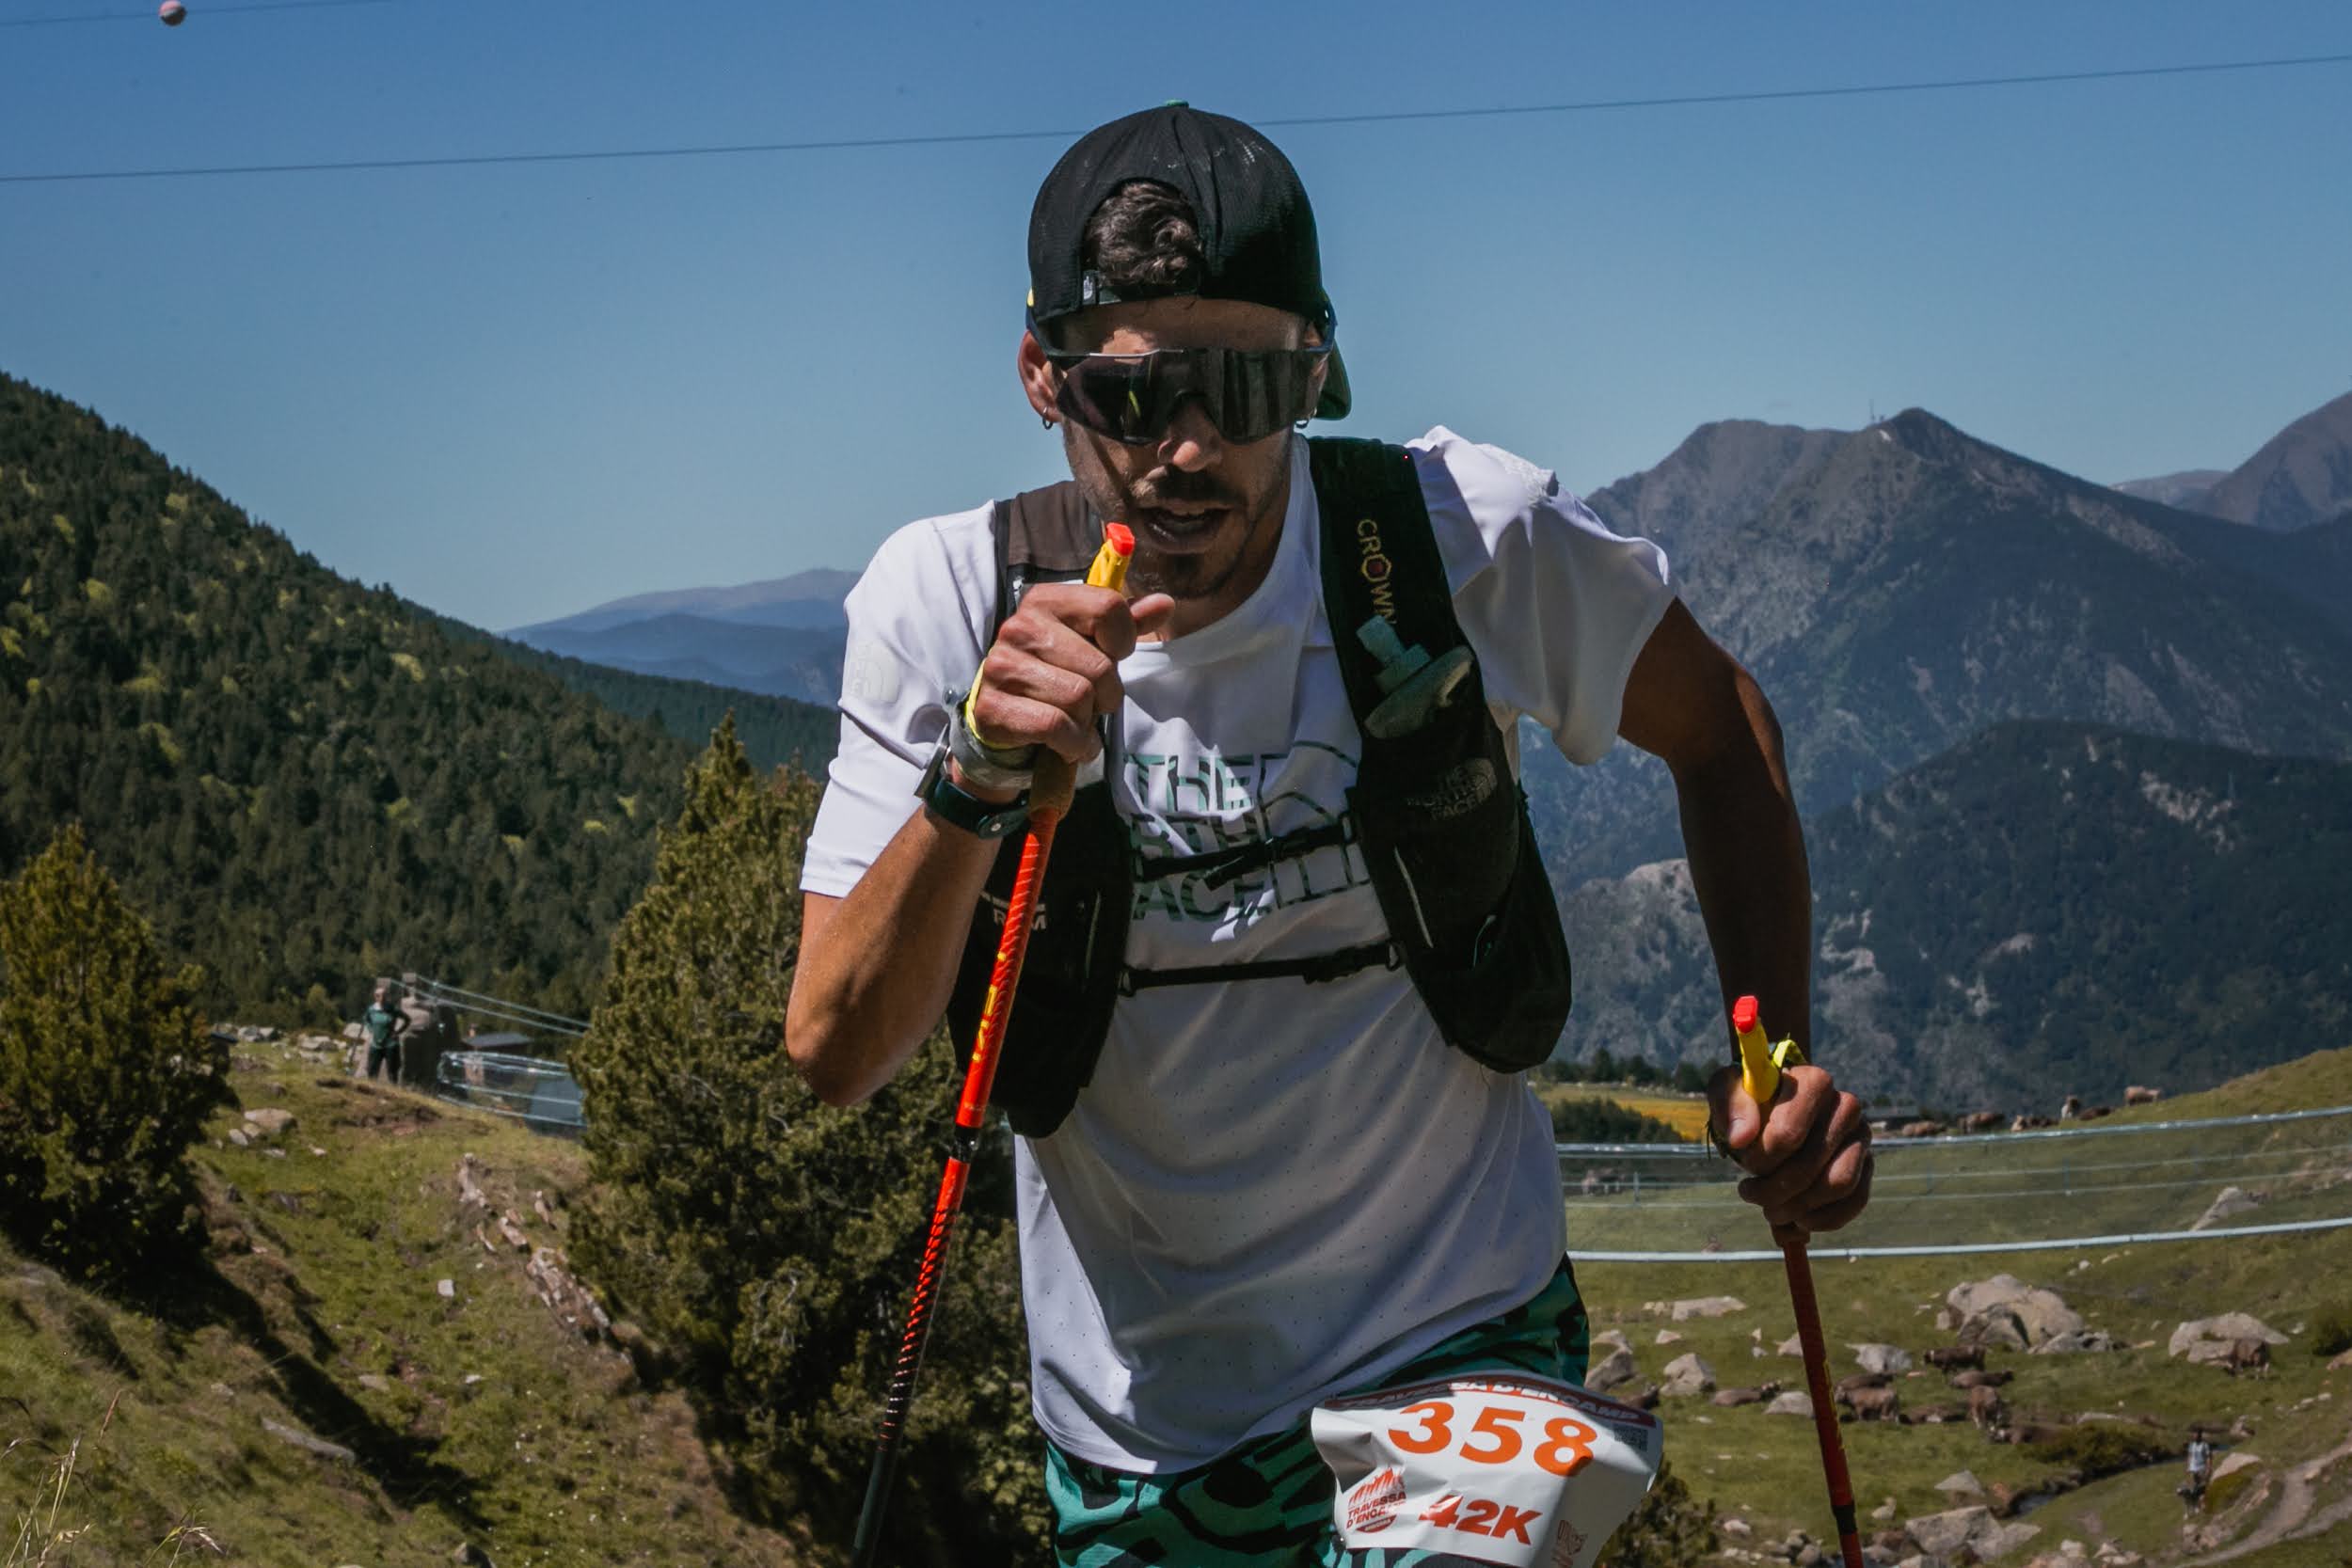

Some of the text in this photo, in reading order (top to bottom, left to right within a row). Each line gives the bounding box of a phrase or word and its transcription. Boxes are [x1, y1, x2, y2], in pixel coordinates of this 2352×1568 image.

[1124, 754, 1254, 812] THE
[1388, 1402, 1597, 1477] 358
[1348, 1491, 1406, 1518] TRAVESSA
[1419, 1493, 1542, 1545] 42K
